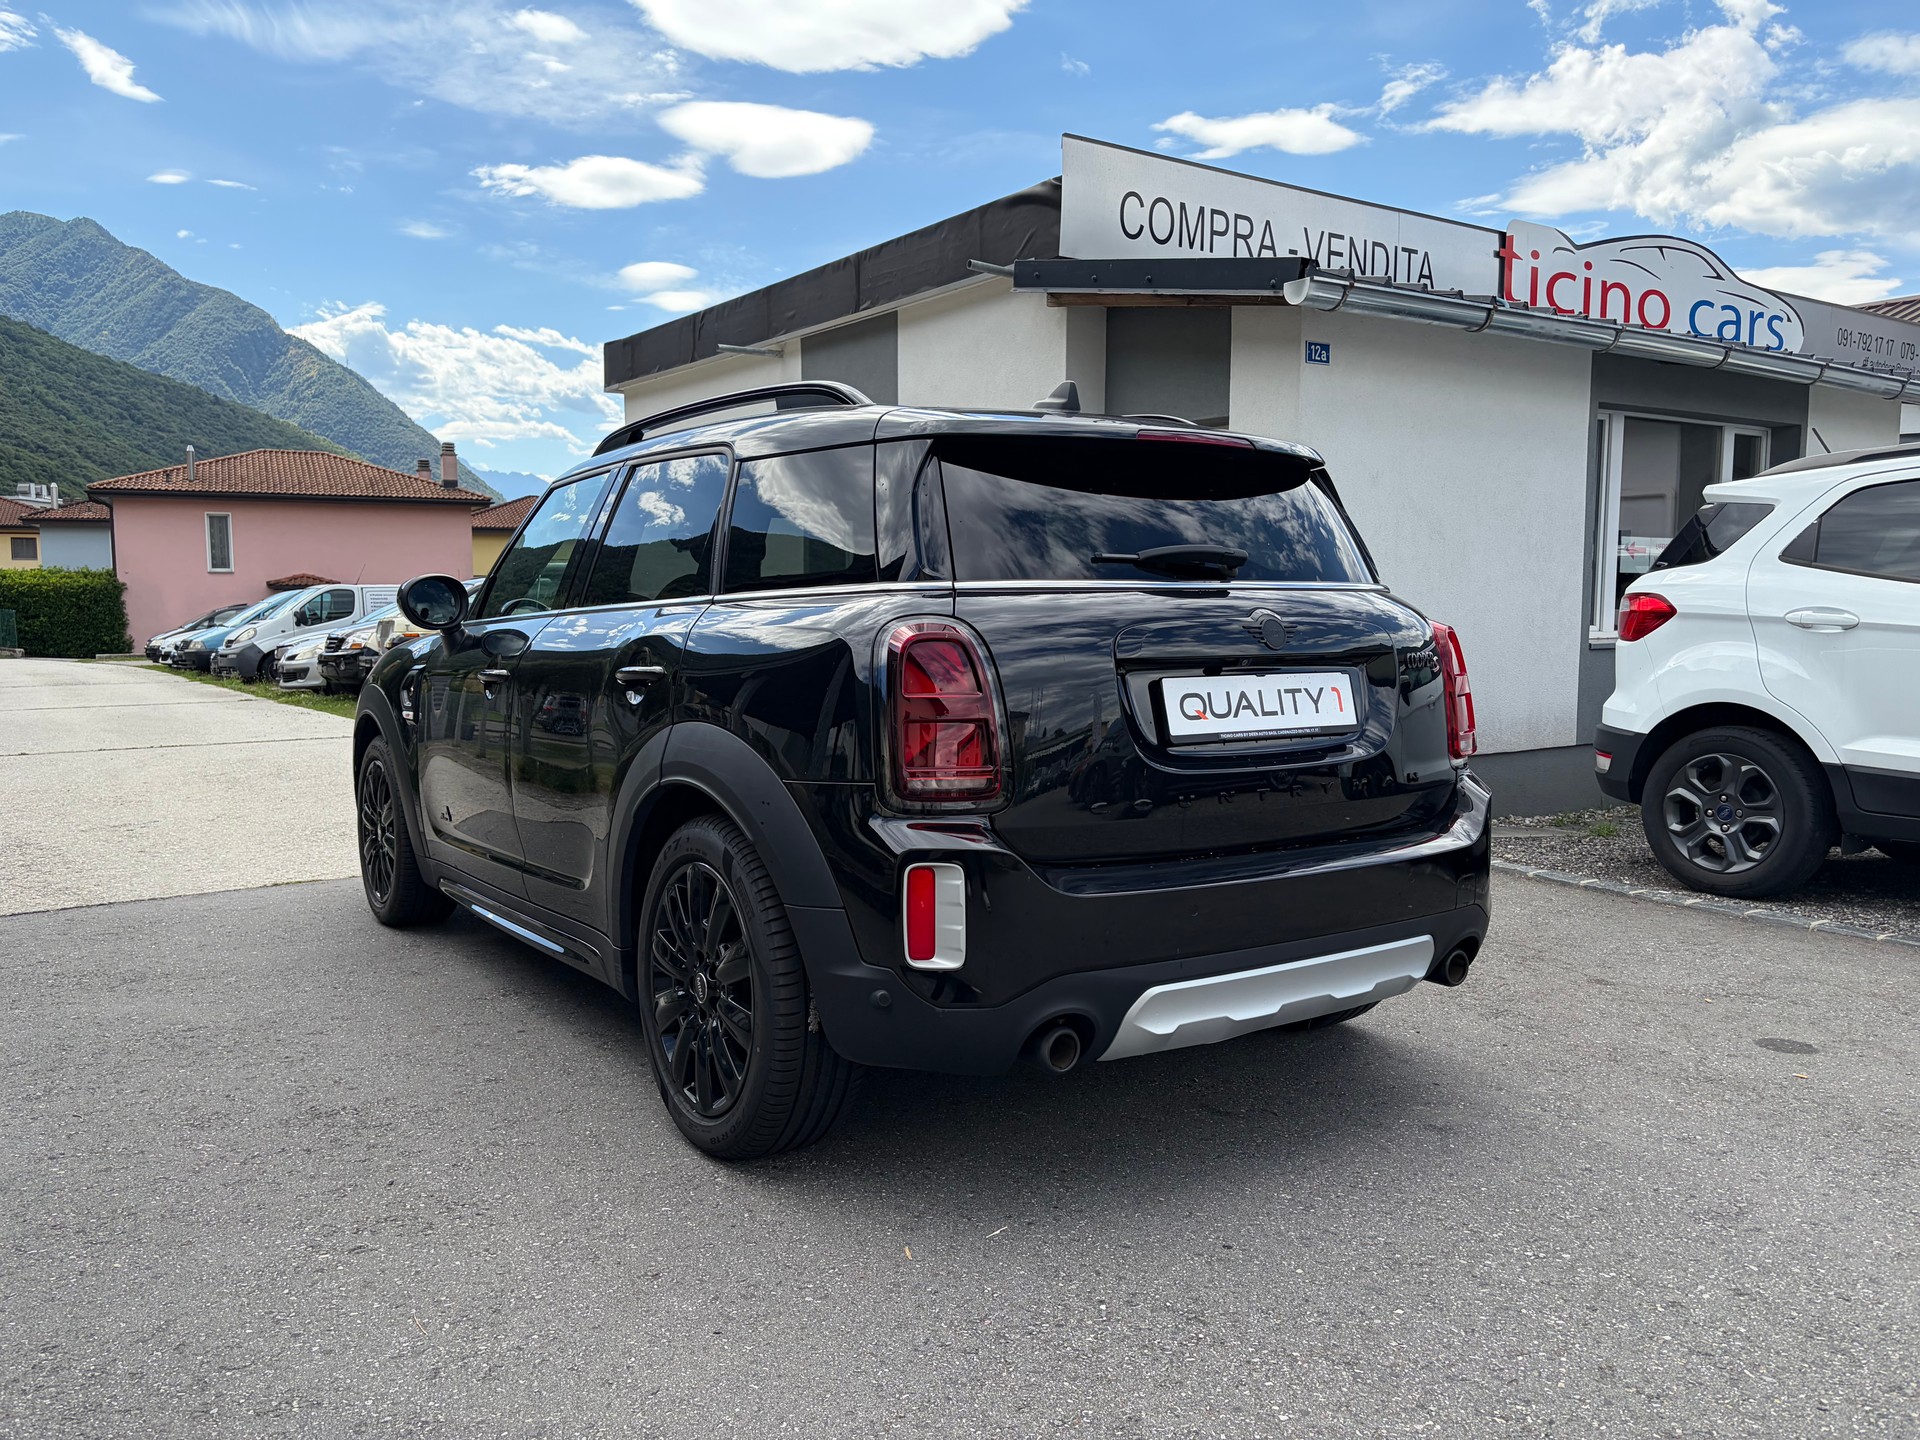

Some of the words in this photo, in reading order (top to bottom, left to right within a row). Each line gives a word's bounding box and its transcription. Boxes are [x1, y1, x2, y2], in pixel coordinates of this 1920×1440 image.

[1119, 190, 1276, 257] COMPRA
[1499, 234, 1671, 328] ticino
[1688, 299, 1785, 350] cars
[1310, 344, 1327, 361] 12a
[1837, 327, 1873, 352] 091-792
[1874, 335, 1884, 354] 17
[1886, 338, 1895, 357] 17
[1406, 651, 1434, 669] COOPER
[1179, 687, 1325, 721] QUALITY
